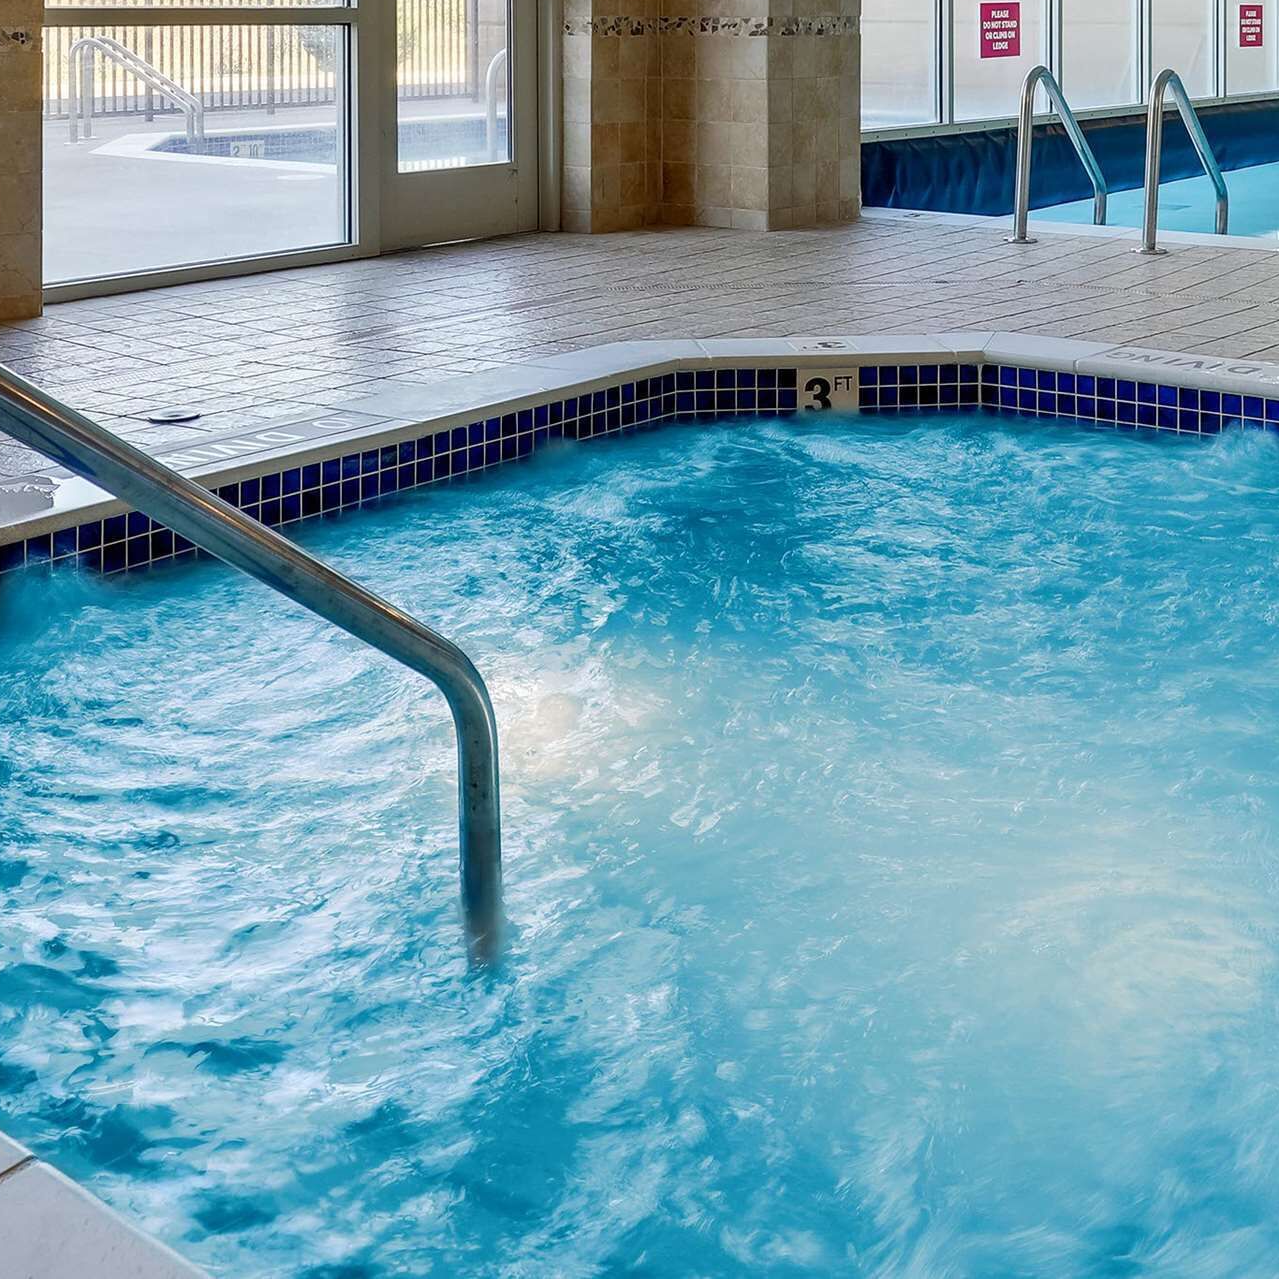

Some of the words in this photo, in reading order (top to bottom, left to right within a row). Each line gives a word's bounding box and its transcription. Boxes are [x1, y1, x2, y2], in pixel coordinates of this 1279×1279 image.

[991, 10, 1009, 19] PLEASE
[992, 41, 1009, 50] LEDGE
[804, 377, 833, 410] 3
[834, 376, 853, 392] FT
